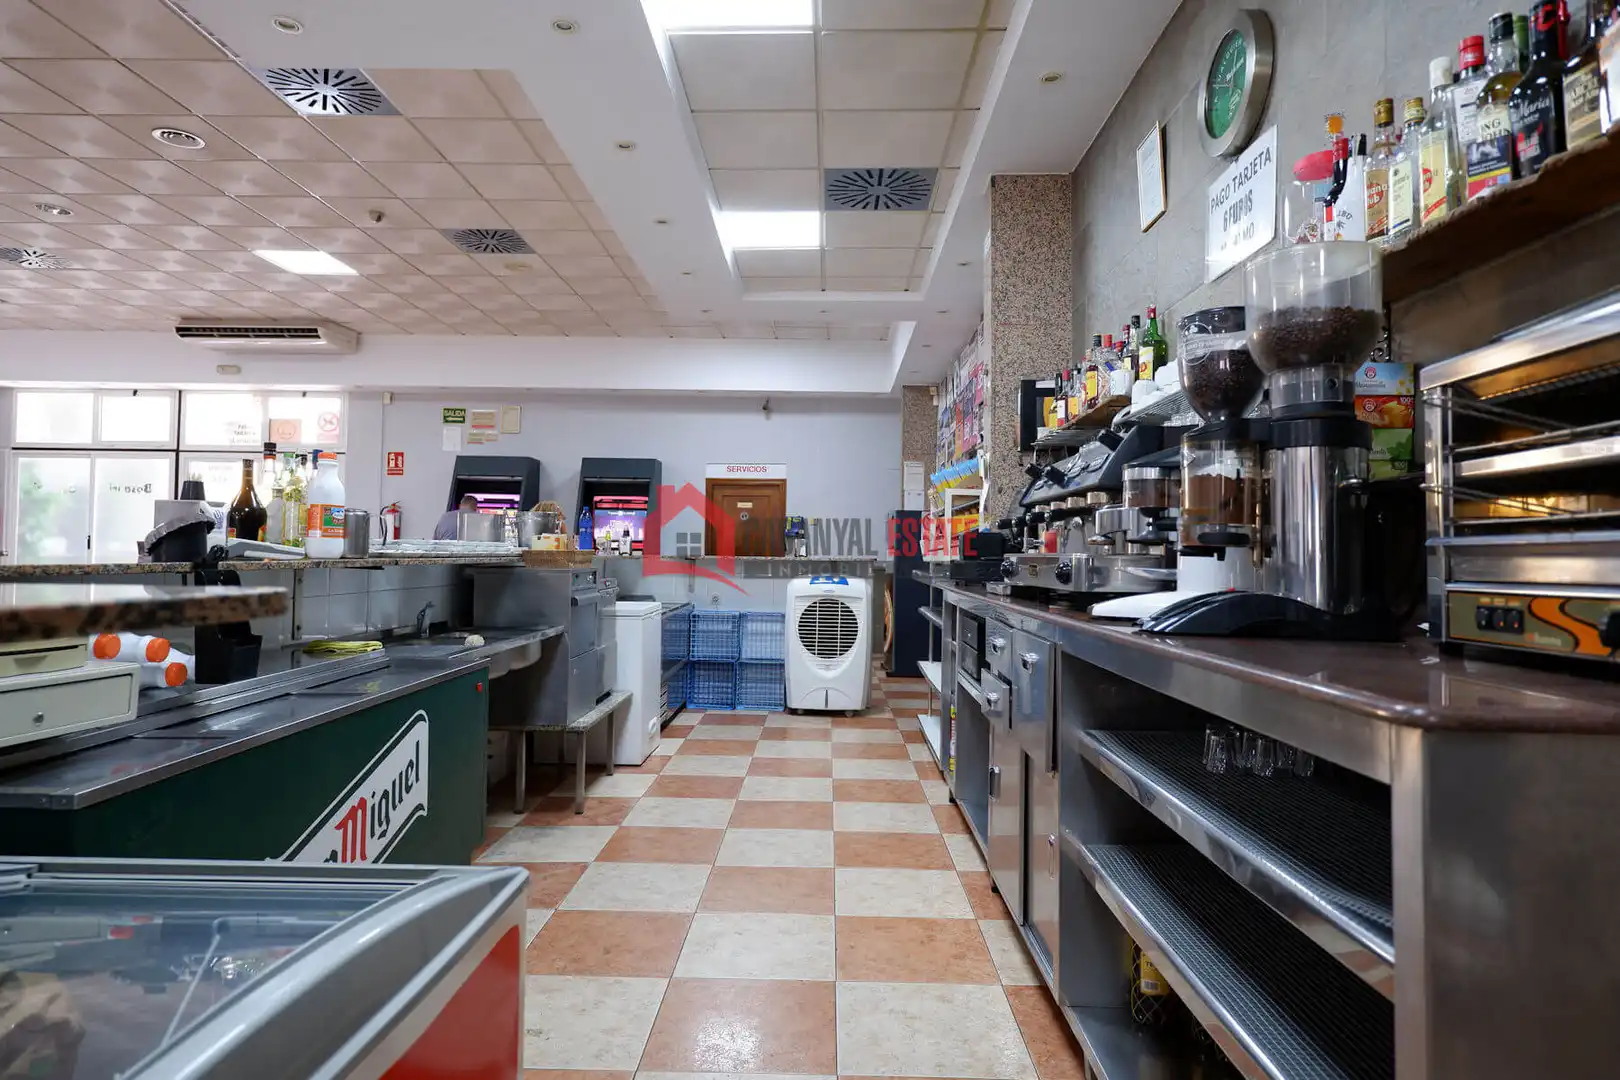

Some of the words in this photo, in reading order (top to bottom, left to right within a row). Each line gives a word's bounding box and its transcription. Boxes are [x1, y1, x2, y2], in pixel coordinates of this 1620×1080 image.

[1210, 184, 1231, 215] PAGO
[1232, 147, 1272, 193] TARJETA
[443, 409, 466, 417] SALIDA
[726, 465, 768, 473] SERVICIOS
[334, 740, 420, 864] Miguel
